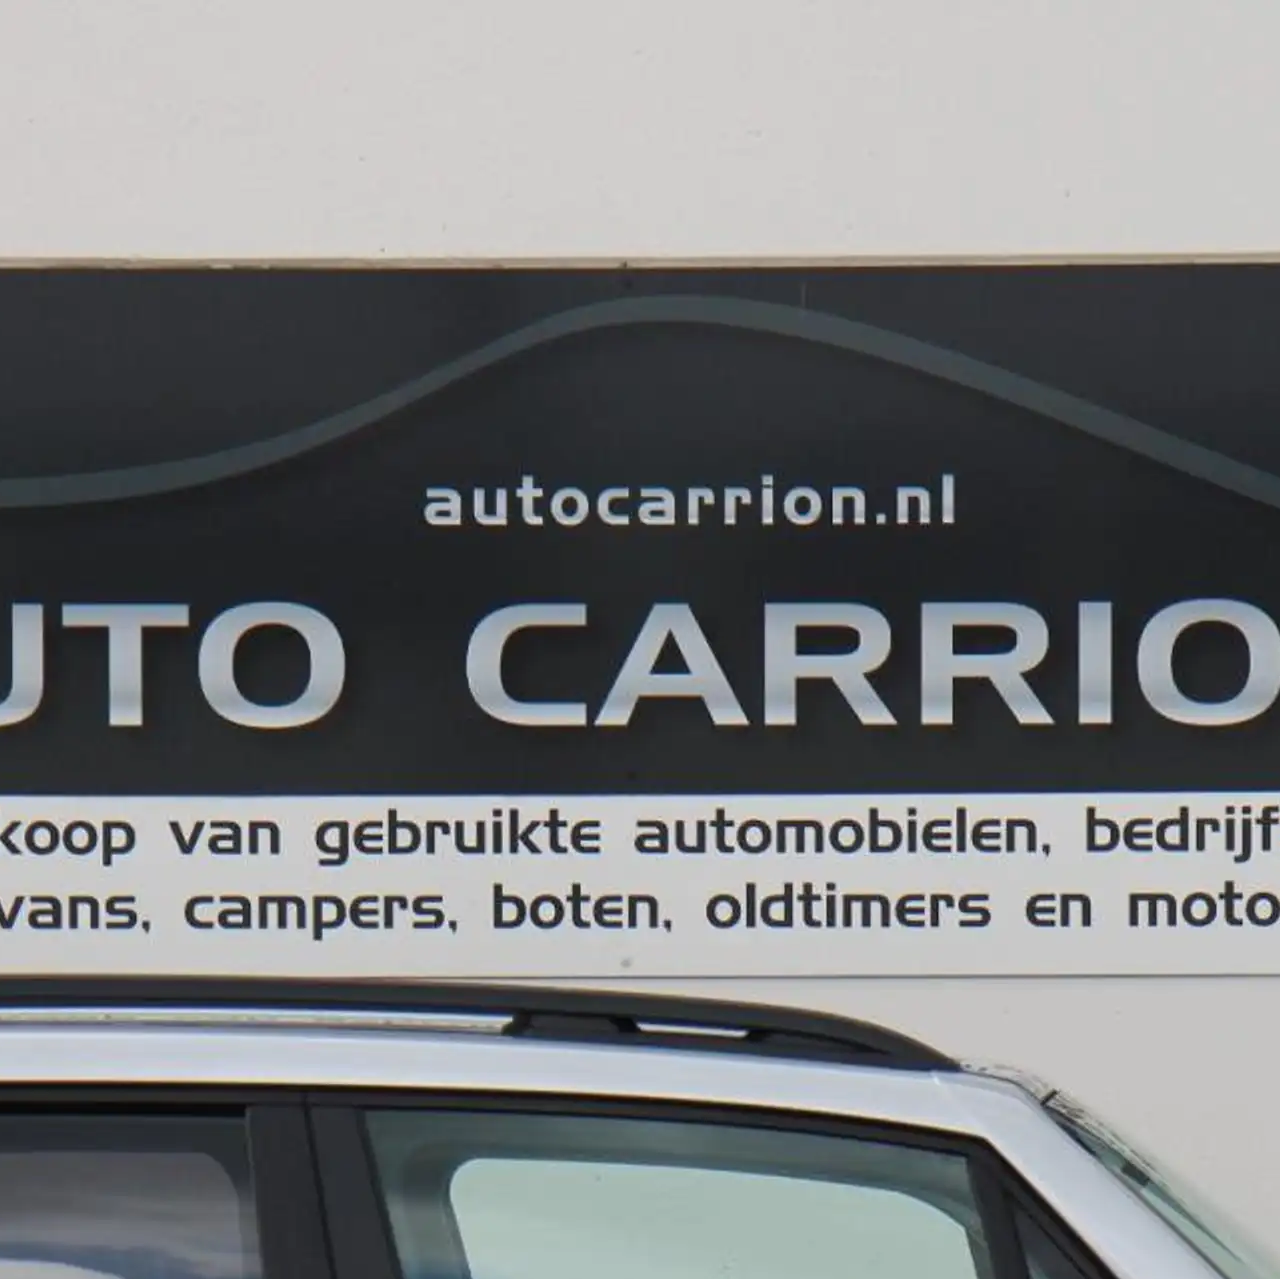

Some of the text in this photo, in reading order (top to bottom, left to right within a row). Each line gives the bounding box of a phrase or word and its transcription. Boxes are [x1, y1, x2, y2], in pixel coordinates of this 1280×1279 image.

[424, 474, 956, 527] autocarrion.nl
[168, 820, 280, 855] van
[315, 808, 601, 867] gebruikte
[634, 807, 1051, 857] automobielen,
[184, 895, 458, 942] campers,
[493, 882, 672, 932] boten,
[705, 882, 992, 929] oldtimers
[1025, 893, 1092, 928] en
